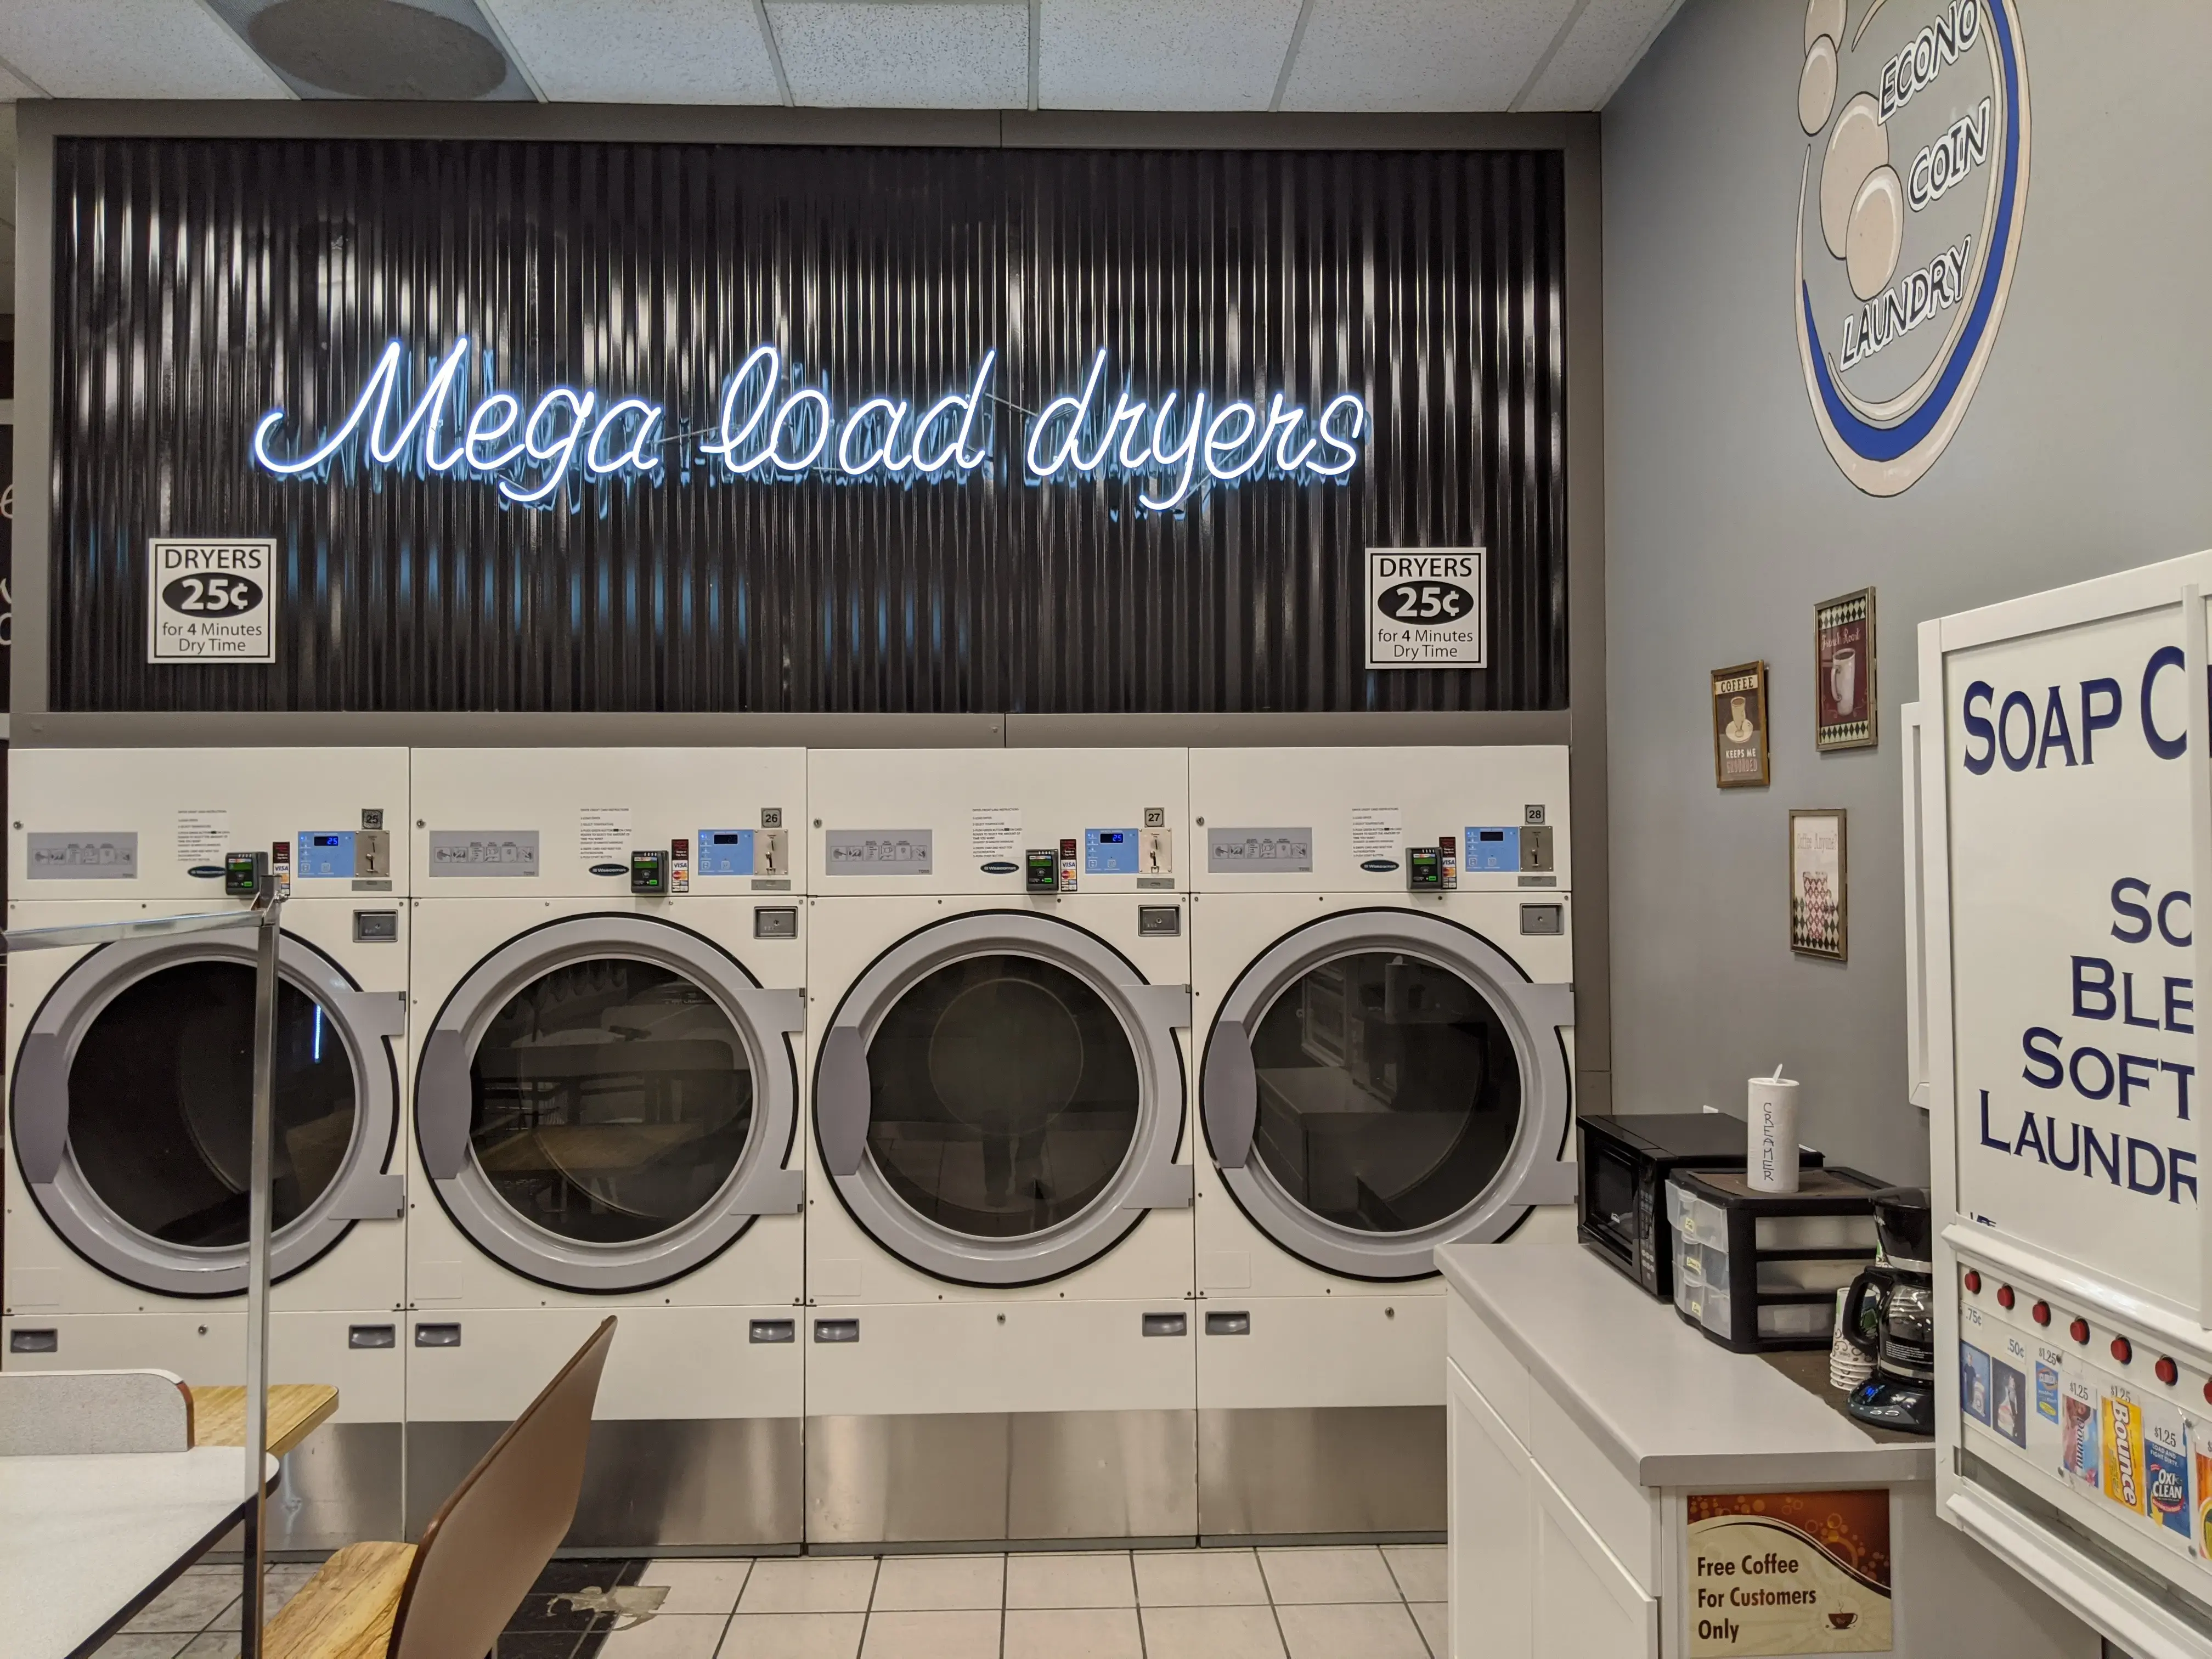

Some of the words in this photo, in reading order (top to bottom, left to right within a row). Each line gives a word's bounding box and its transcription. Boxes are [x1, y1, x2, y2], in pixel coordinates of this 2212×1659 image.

[1878, 0, 1980, 125] ECONO
[1908, 97, 1990, 211] COIN
[1841, 235, 1970, 371] LAUNDRY
[252, 336, 659, 502] Mega
[700, 345, 993, 476] load
[1026, 347, 1366, 511] dryers
[165, 549, 262, 569] DRYERS
[1380, 558, 1472, 577] DRYERS
[181, 578, 249, 610] 25¢
[1396, 586, 1460, 617] 25¢
[162, 622, 183, 635] for
[187, 624, 197, 636] 4
[201, 623, 262, 636] Minutes
[1378, 629, 1397, 642] for
[1401, 630, 1410, 642] 4
[1415, 629, 1473, 642] Minutes
[179, 638, 205, 654] Dry
[208, 638, 246, 652] Time
[1394, 645, 1419, 661] Dry
[1421, 644, 1458, 657] Time
[1721, 677, 1753, 693] COFFEE
[1963, 676, 2123, 776] SOAP
[1725, 749, 1745, 759] KEEPS
[1747, 748, 1756, 757] ME
[366, 815, 379, 823] 25
[765, 814, 778, 823] 26
[1148, 814, 1160, 822] 27
[1529, 810, 1541, 819] 28
[2069, 955, 2194, 1034] BLE
[2022, 1026, 2196, 1121] SOFT
[1763, 1102, 1775, 1181] CREAMER
[2039, 1347, 2056, 1365] $1.25
[2070, 1382, 2088, 1401] $1.25
[2154, 1426, 2176, 1447] $1.25
[2111, 1401, 2137, 1506] Bounce
[2158, 1468, 2175, 1485] OXI
[2153, 1481, 2182, 1500] CLEAN
[1697, 1556, 1735, 1577] Free
[1741, 1553, 1799, 1575] Coffee
[1698, 1588, 1725, 1609] For
[1730, 1587, 1816, 1607] Customers
[1698, 1618, 1740, 1644] Only
